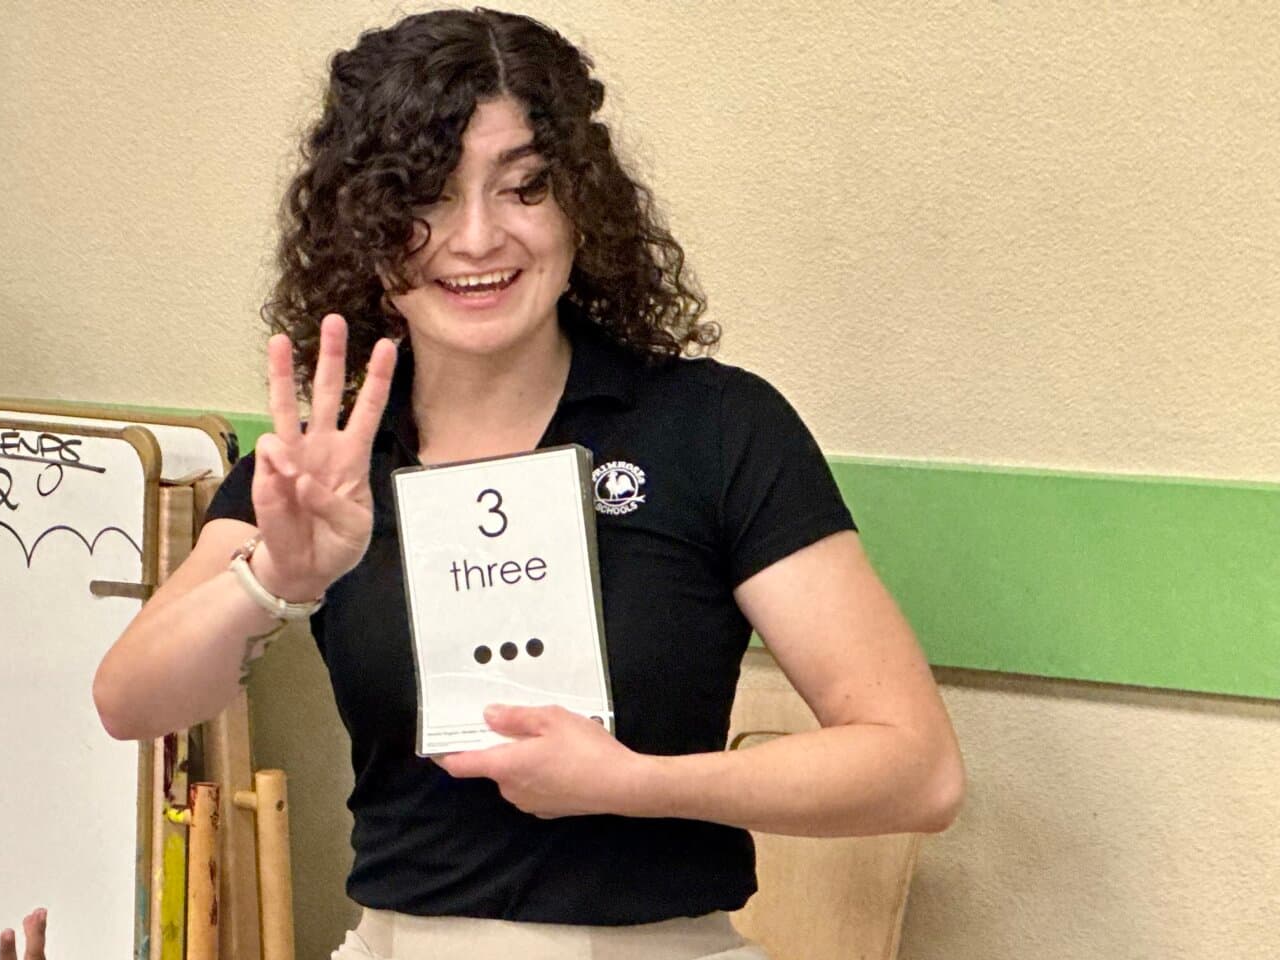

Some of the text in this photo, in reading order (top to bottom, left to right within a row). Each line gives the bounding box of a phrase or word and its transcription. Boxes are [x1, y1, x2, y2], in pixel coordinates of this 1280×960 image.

[592, 461, 646, 485] PRIMROSE
[476, 488, 508, 538] 3
[595, 501, 638, 515] SCHOOLS
[450, 557, 547, 591] three
